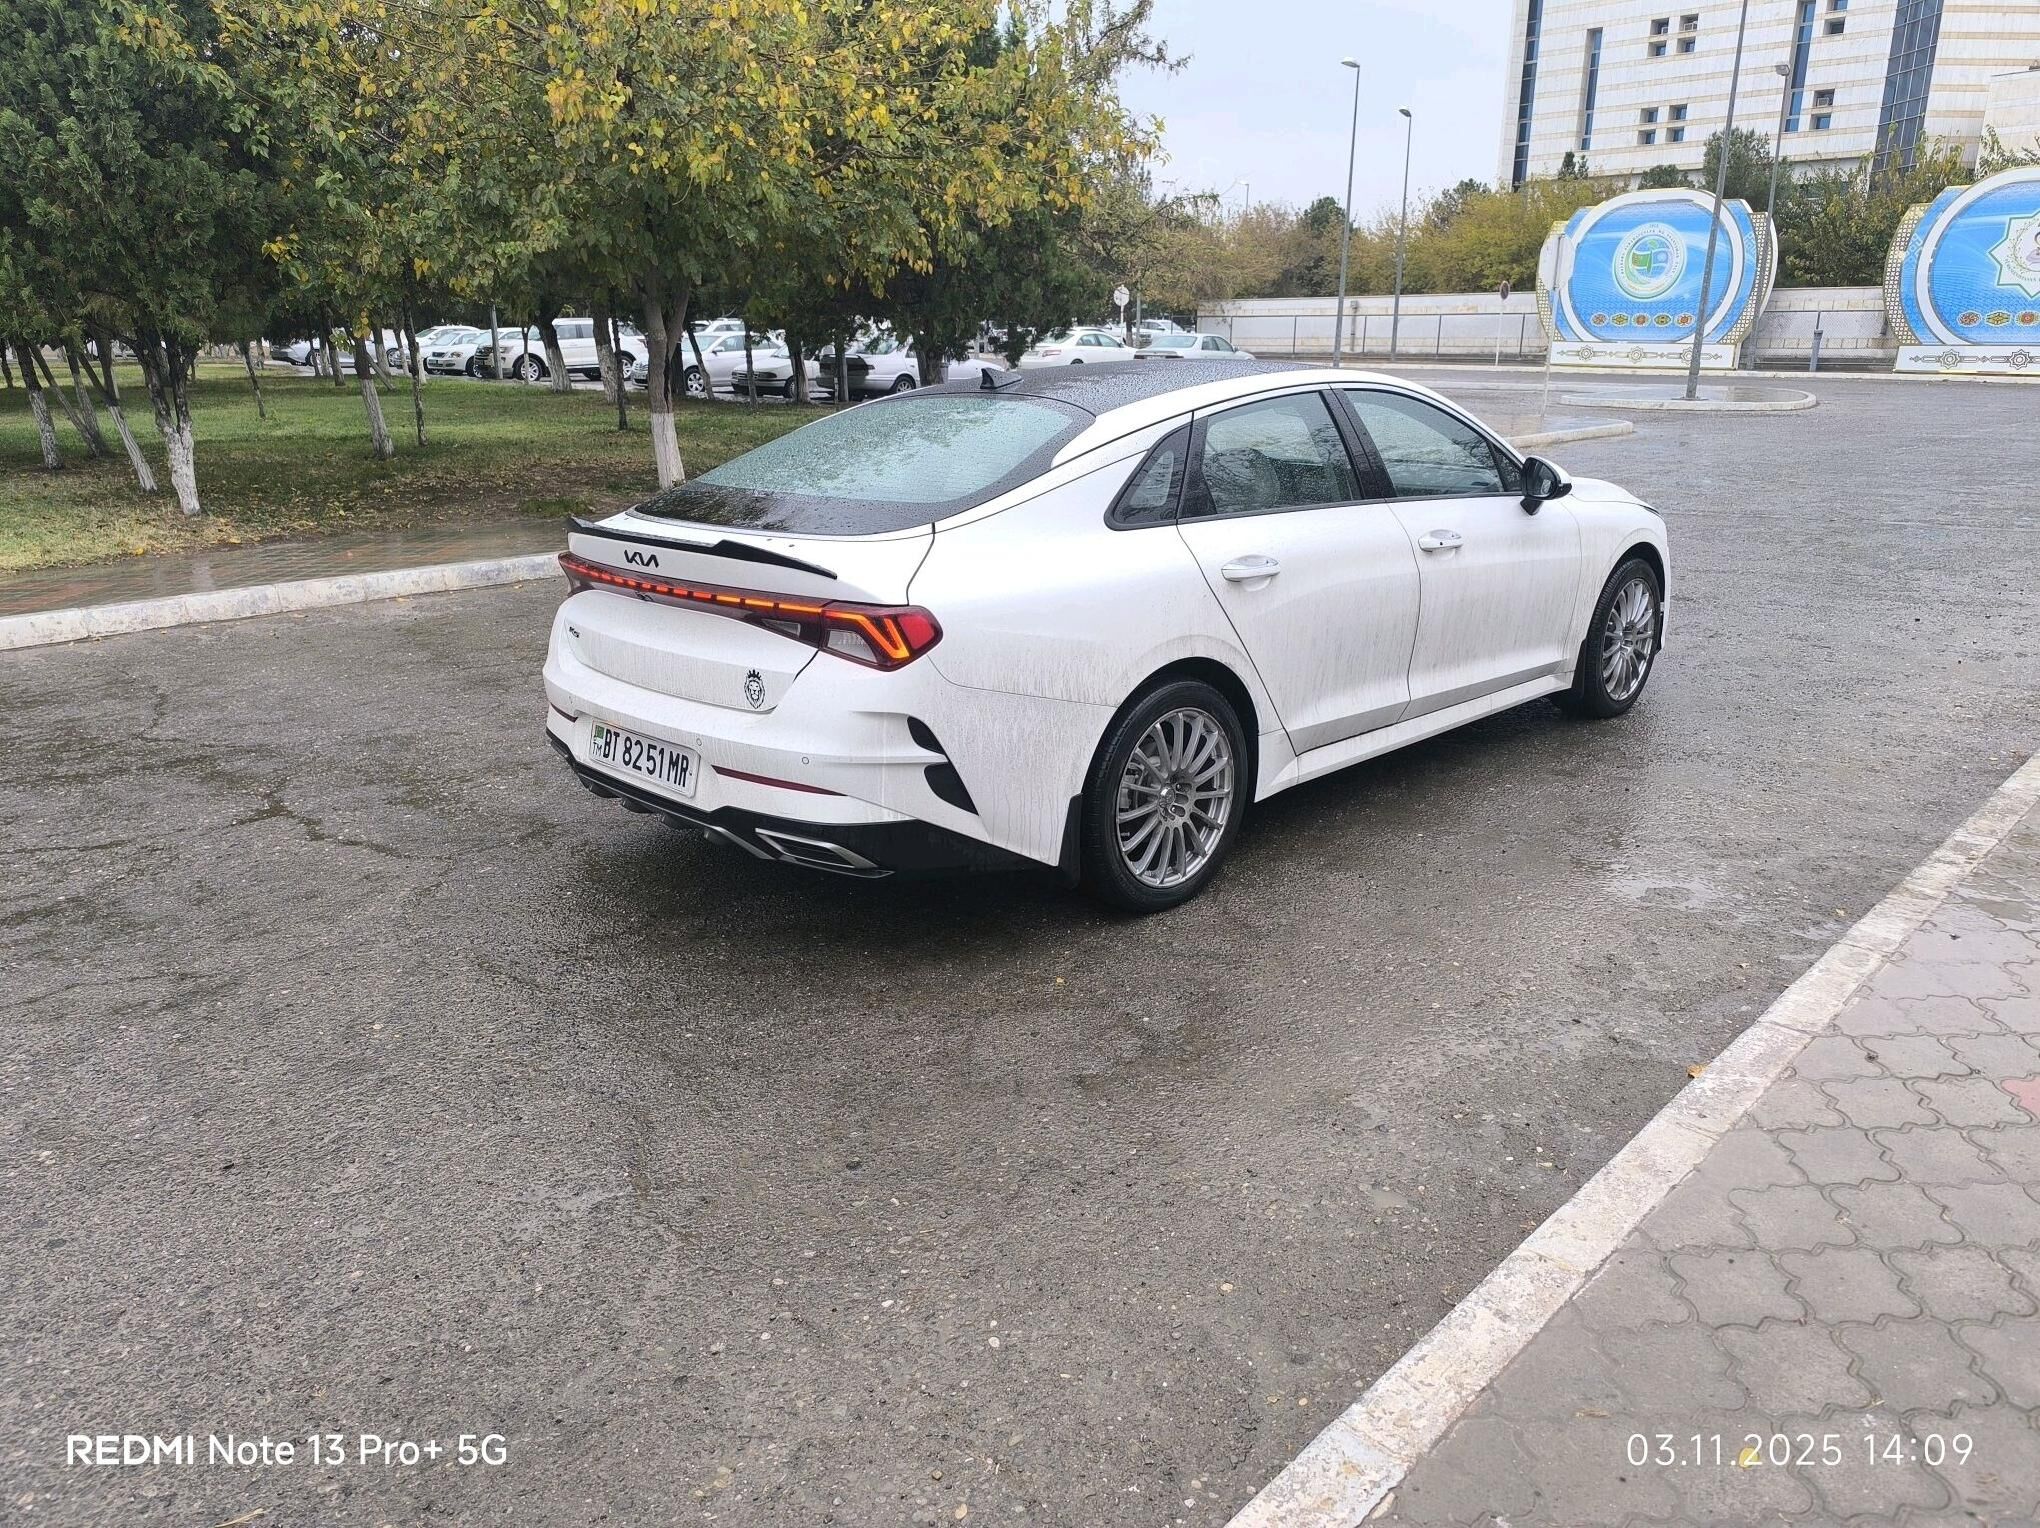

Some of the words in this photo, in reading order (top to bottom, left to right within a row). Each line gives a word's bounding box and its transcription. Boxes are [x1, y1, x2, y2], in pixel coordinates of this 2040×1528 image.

[624, 549, 659, 568] KIA
[603, 728, 620, 761] BT
[622, 736, 665, 778] 8251
[667, 750, 689, 787] MR
